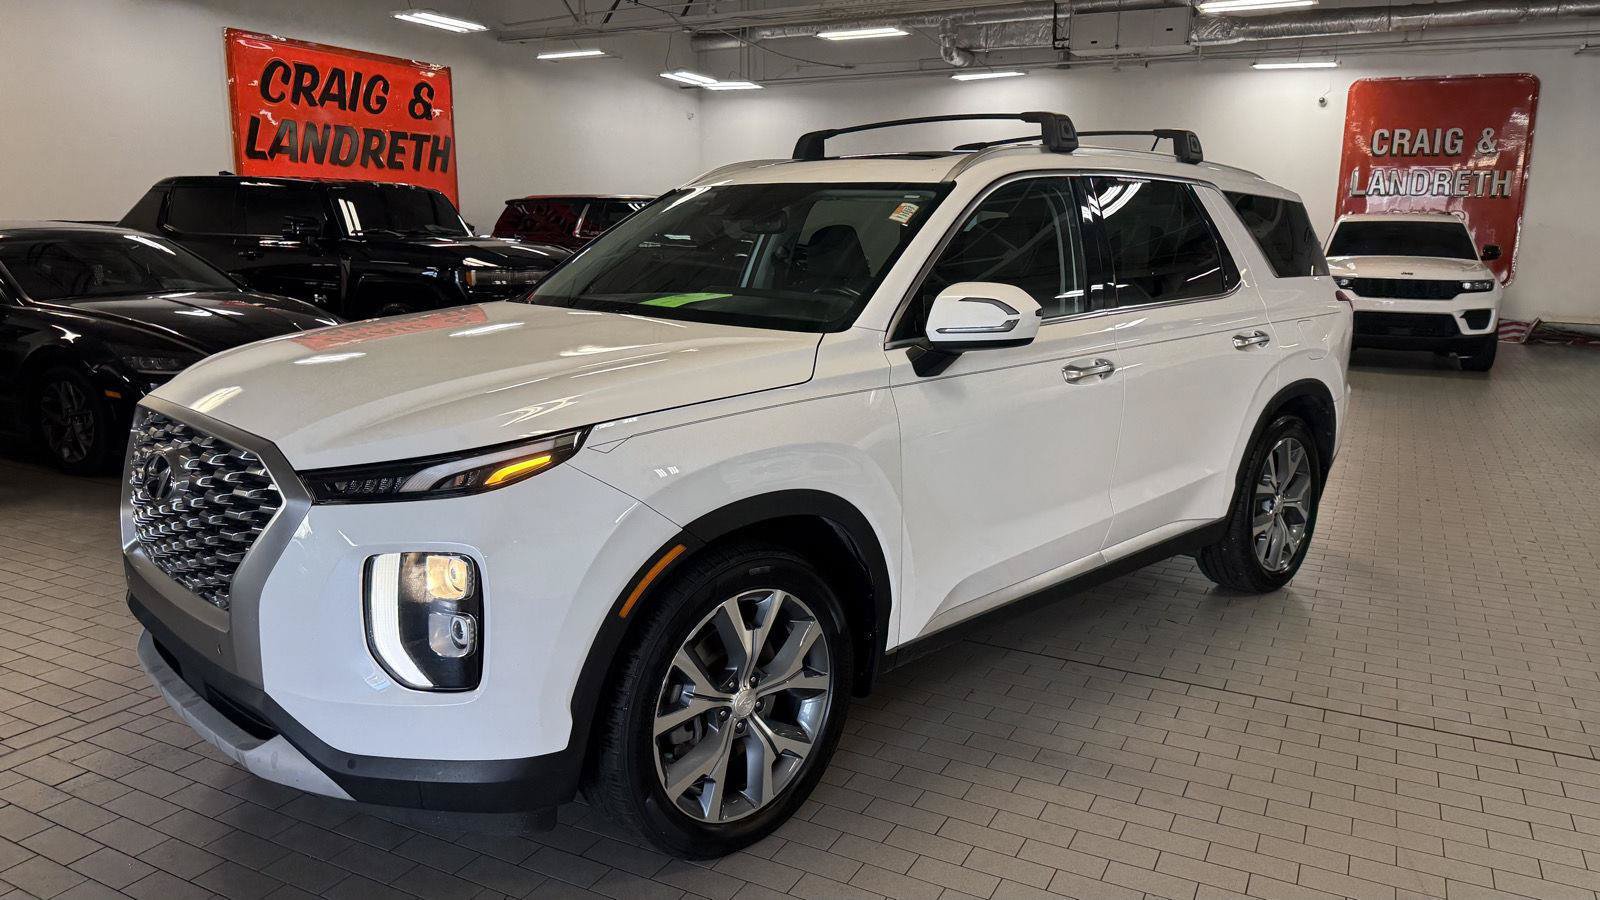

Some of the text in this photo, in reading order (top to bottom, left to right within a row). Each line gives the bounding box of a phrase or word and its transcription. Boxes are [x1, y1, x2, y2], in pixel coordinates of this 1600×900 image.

[260, 59, 435, 120] CRAIG &
[245, 115, 451, 173] LANDRETH
[1371, 127, 1497, 156] CRAIG &
[1350, 168, 1513, 198] LANDRETH
